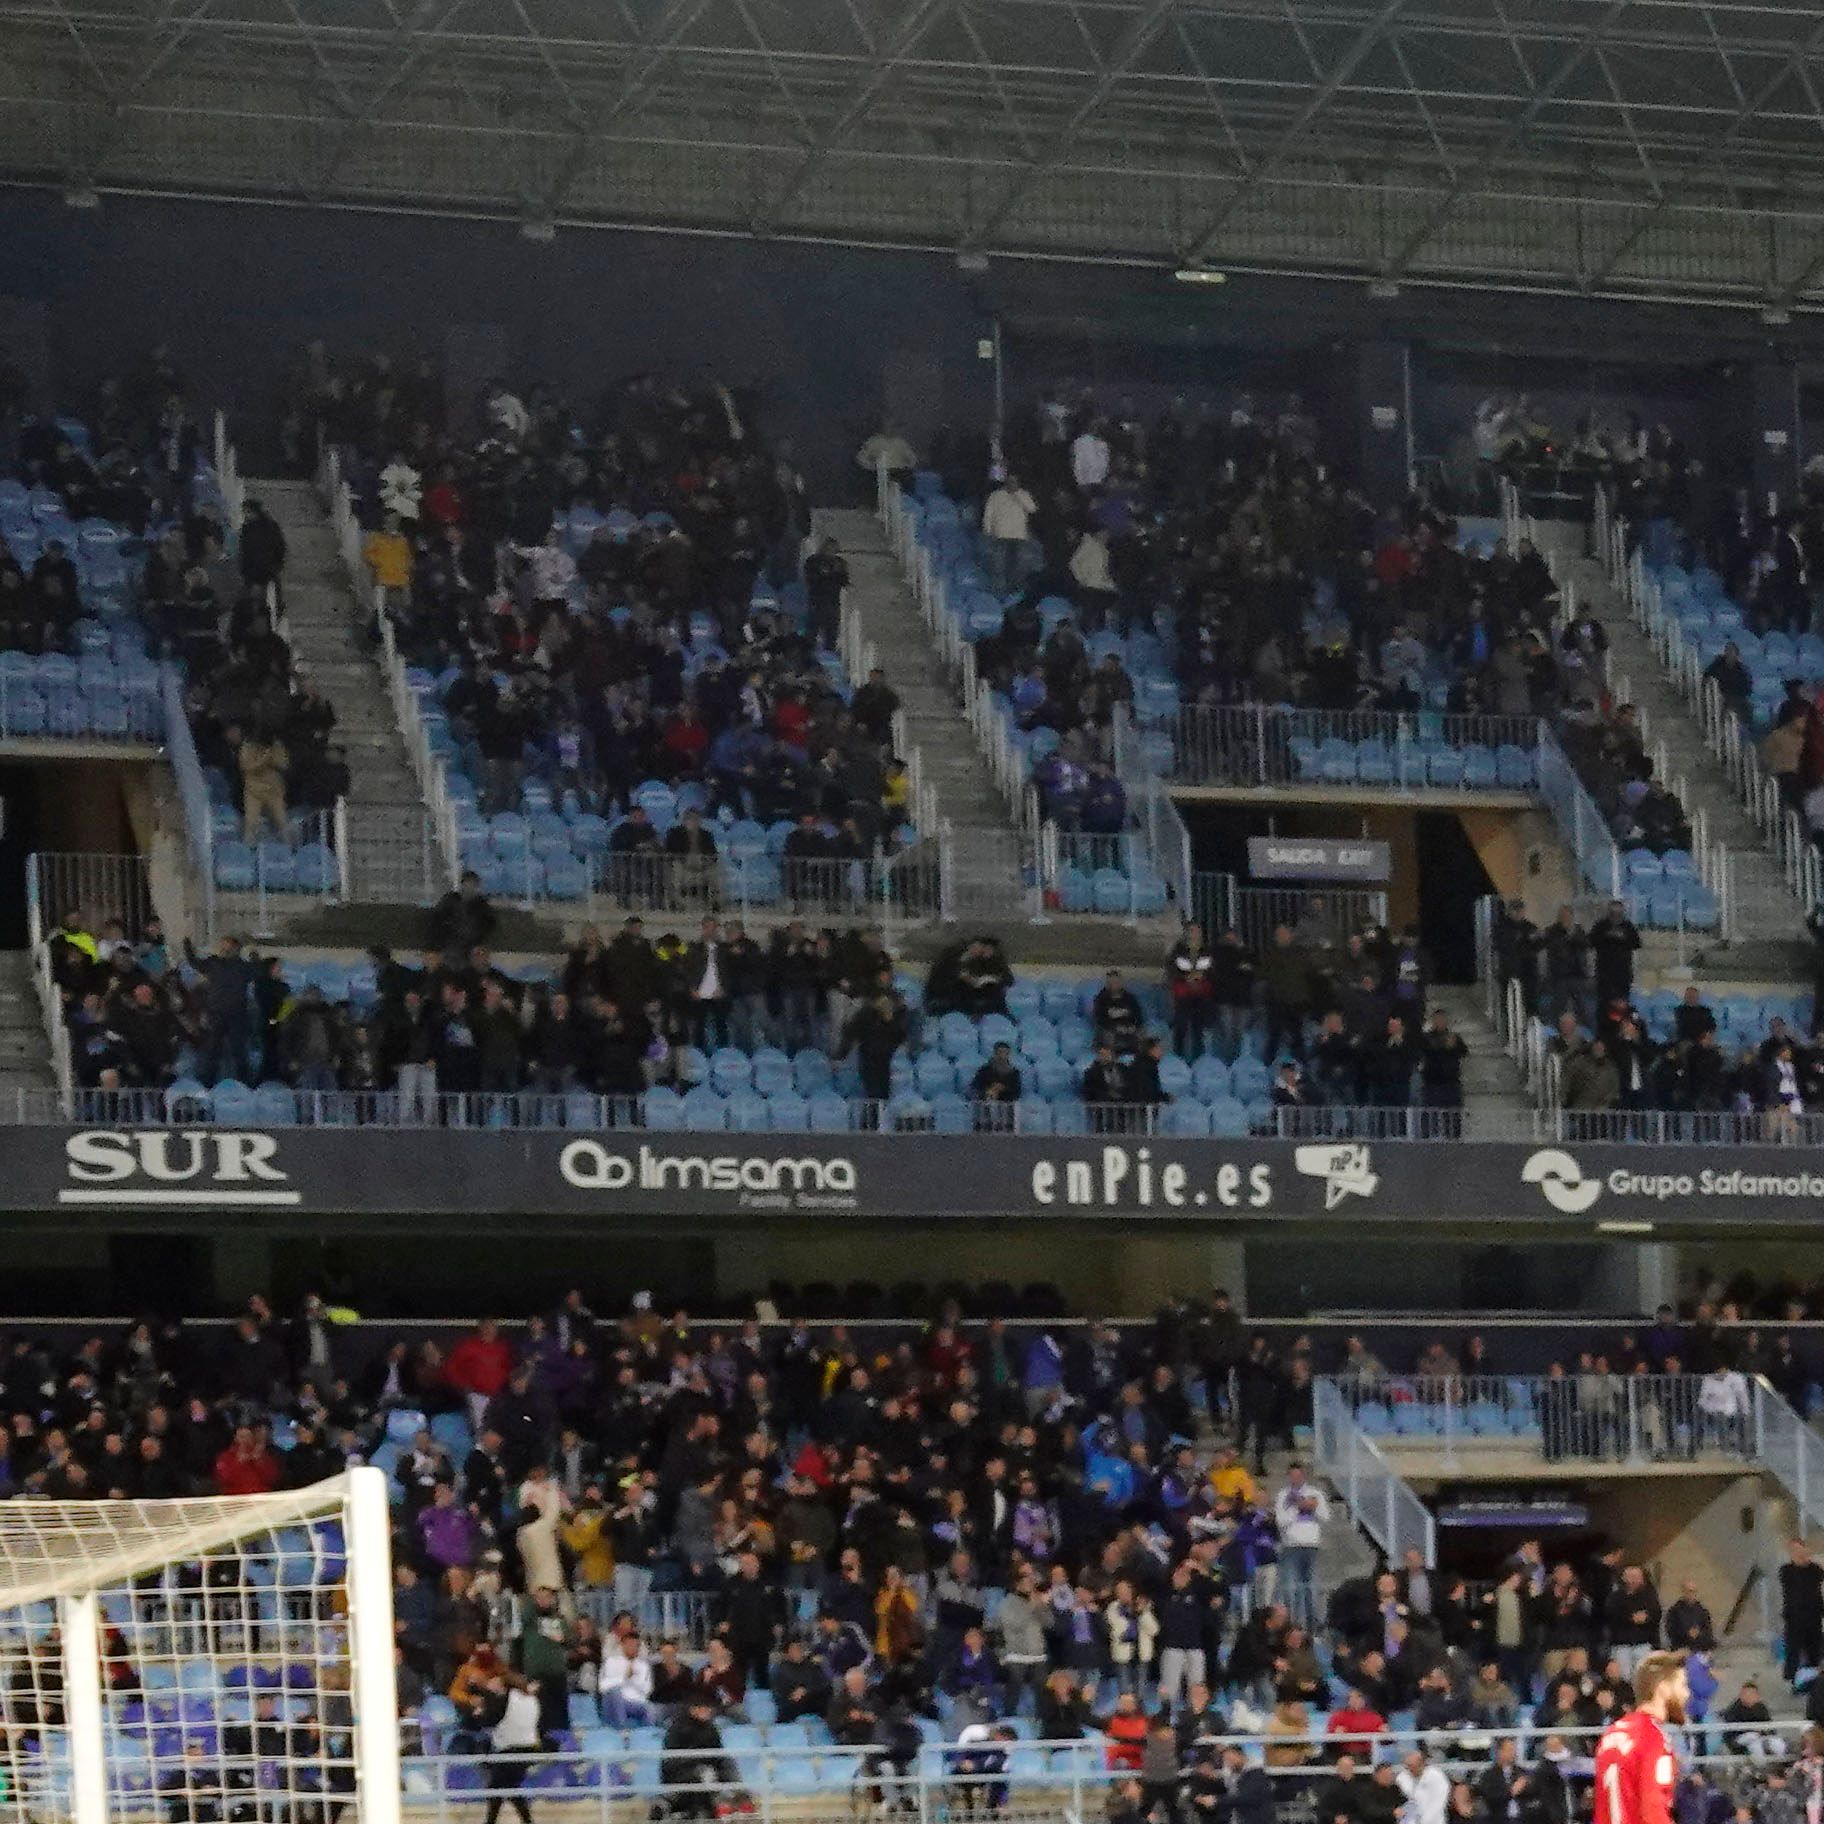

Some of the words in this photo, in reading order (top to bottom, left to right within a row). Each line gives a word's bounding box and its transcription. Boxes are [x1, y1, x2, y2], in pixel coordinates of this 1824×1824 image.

[65, 1130, 288, 1182] SUR
[1032, 1145, 1273, 1207] enPie.es
[1608, 1168, 1694, 1200] Grupo
